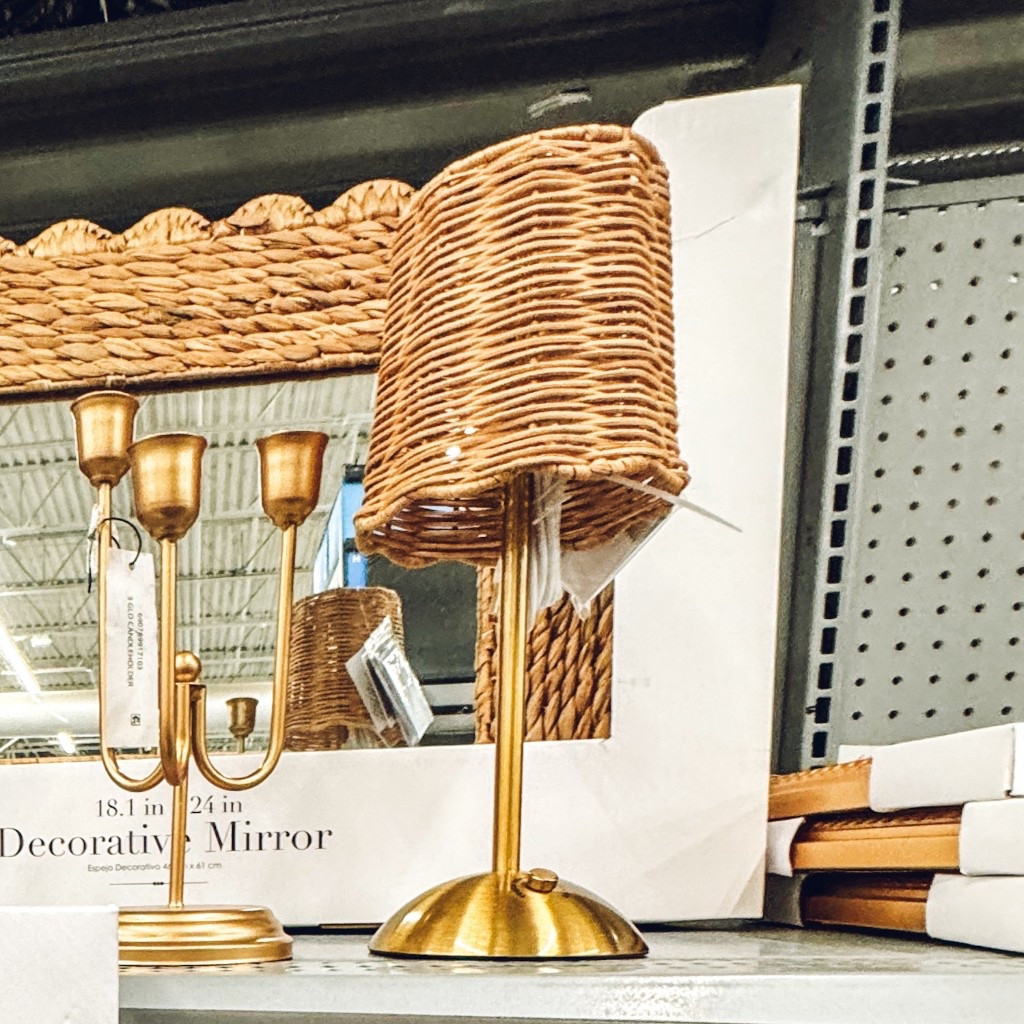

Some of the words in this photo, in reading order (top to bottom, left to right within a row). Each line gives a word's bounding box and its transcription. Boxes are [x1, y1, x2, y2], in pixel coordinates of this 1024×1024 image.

[96, 798, 135, 817] 18.1
[144, 798, 164, 816] in
[190, 795, 214, 814] 24
[222, 795, 243, 813] in
[205, 820, 333, 853] Mirror
[87, 864, 113, 873] Espejo
[115, 863, 161, 872] Decorativo
